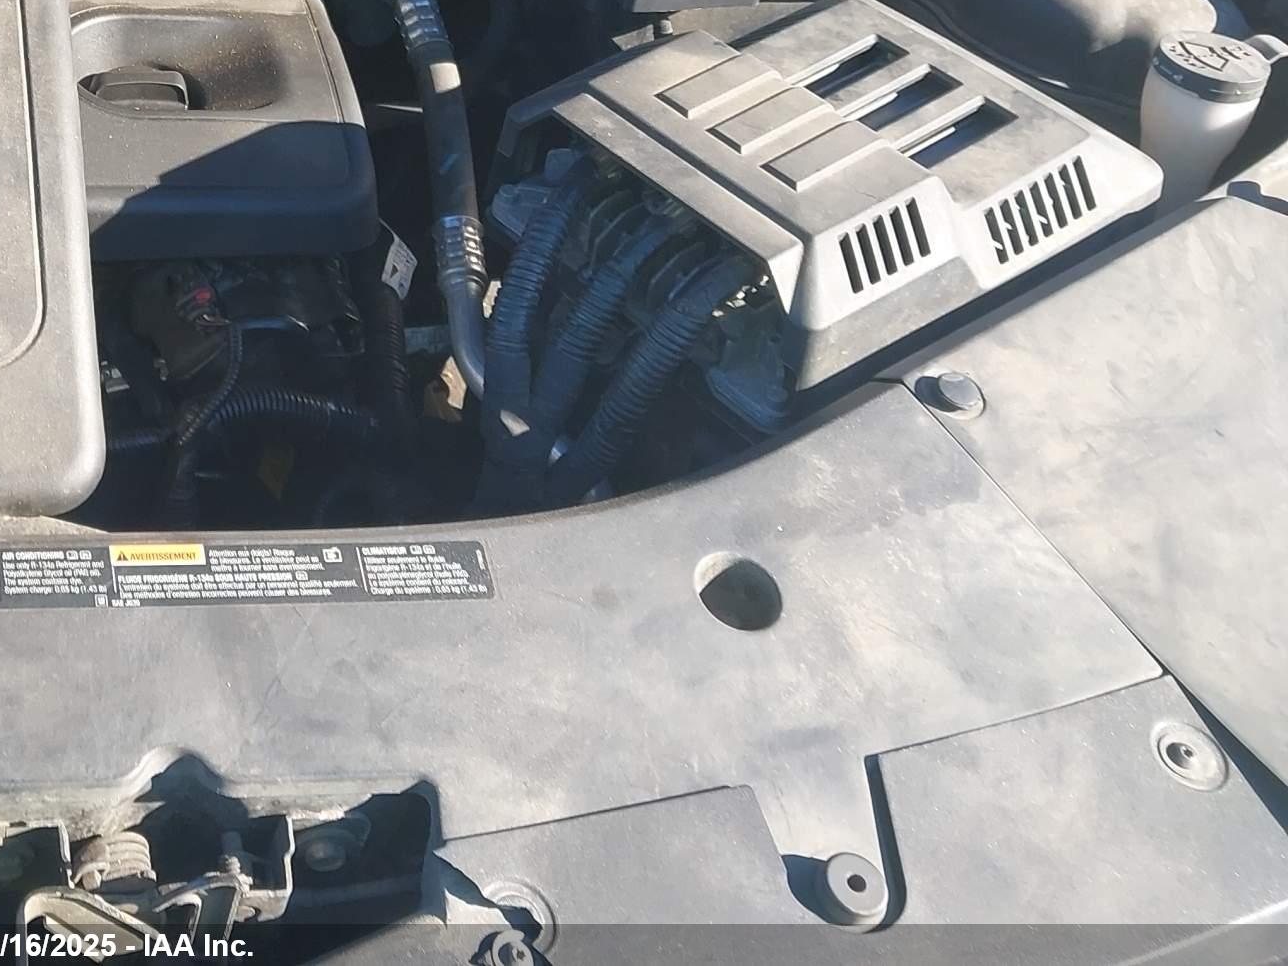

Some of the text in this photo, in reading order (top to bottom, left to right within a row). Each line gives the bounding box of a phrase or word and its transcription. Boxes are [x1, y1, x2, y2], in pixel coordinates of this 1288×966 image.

[2, 551, 64, 560] AIR CONDITIONING
[131, 552, 196, 561] AVERTISSEMENT
[16, 562, 30, 570] only
[92, 560, 105, 569] and
[4, 578, 16, 586] The
[42, 577, 69, 585] contains
[4, 586, 28, 595] System
[70, 585, 80, 594] kg
